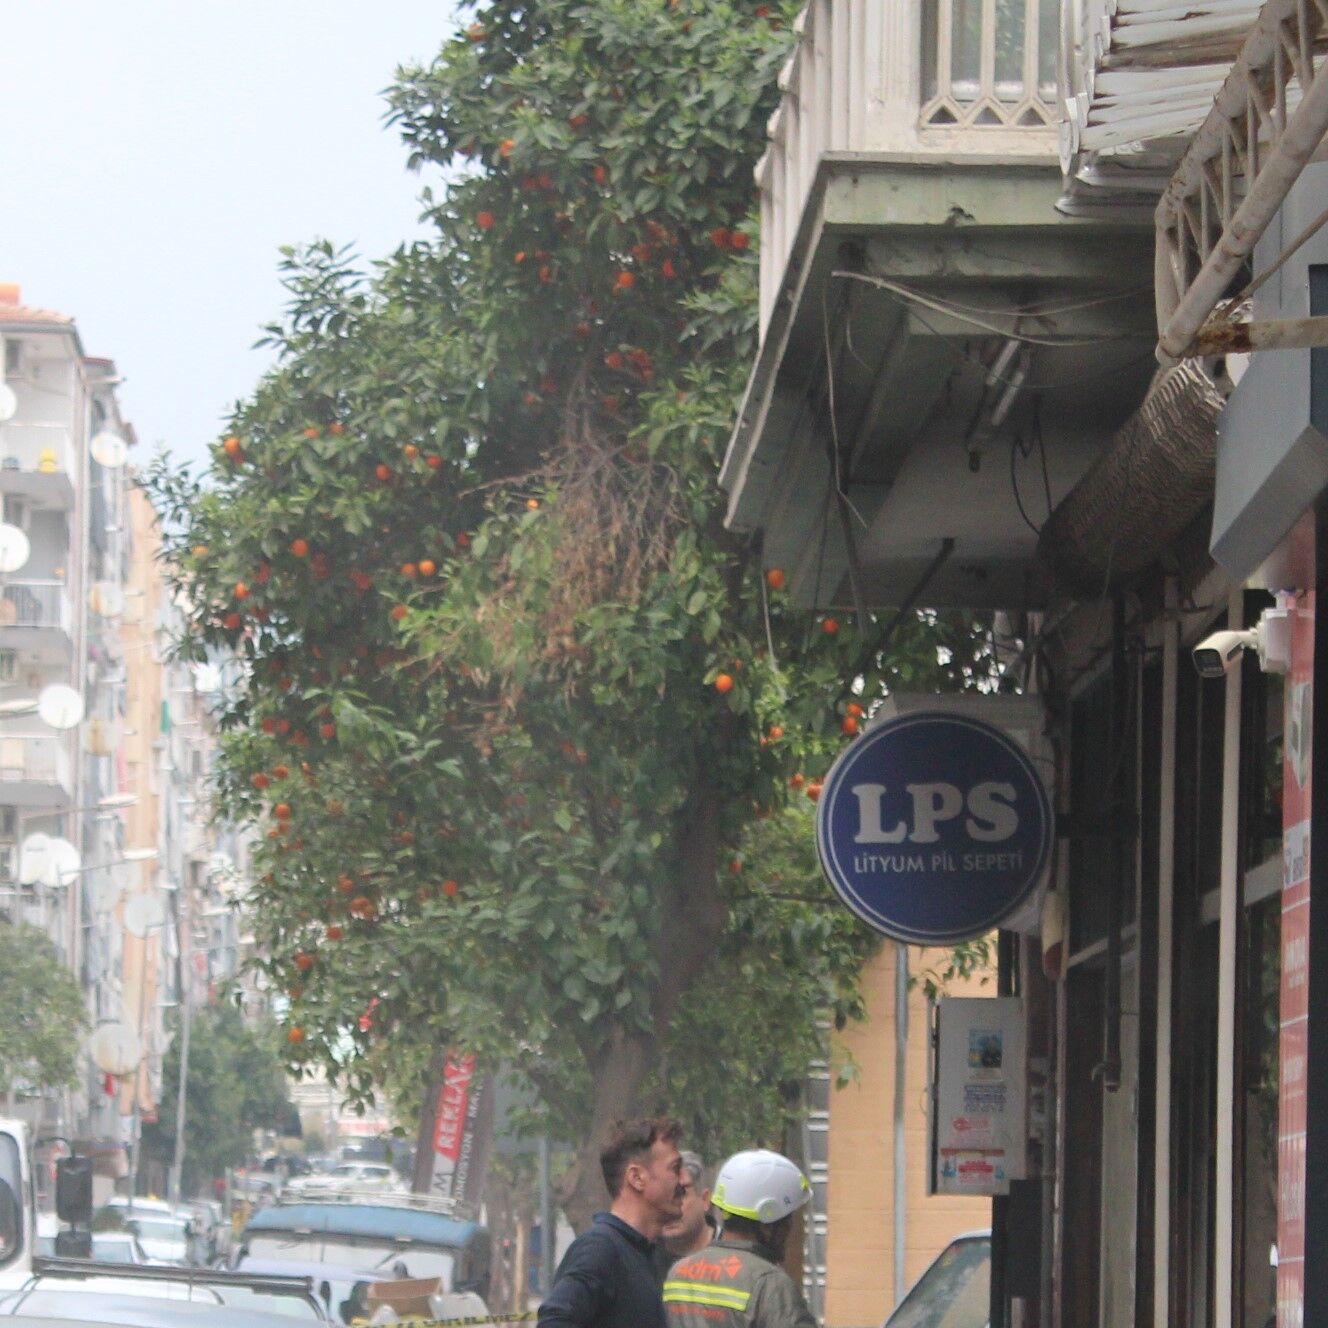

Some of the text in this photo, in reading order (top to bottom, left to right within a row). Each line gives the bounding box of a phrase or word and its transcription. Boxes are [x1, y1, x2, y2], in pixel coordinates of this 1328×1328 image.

[851, 782, 1019, 843] LPS
[854, 850, 1024, 874] LİTYUM PİL SEPETİ
